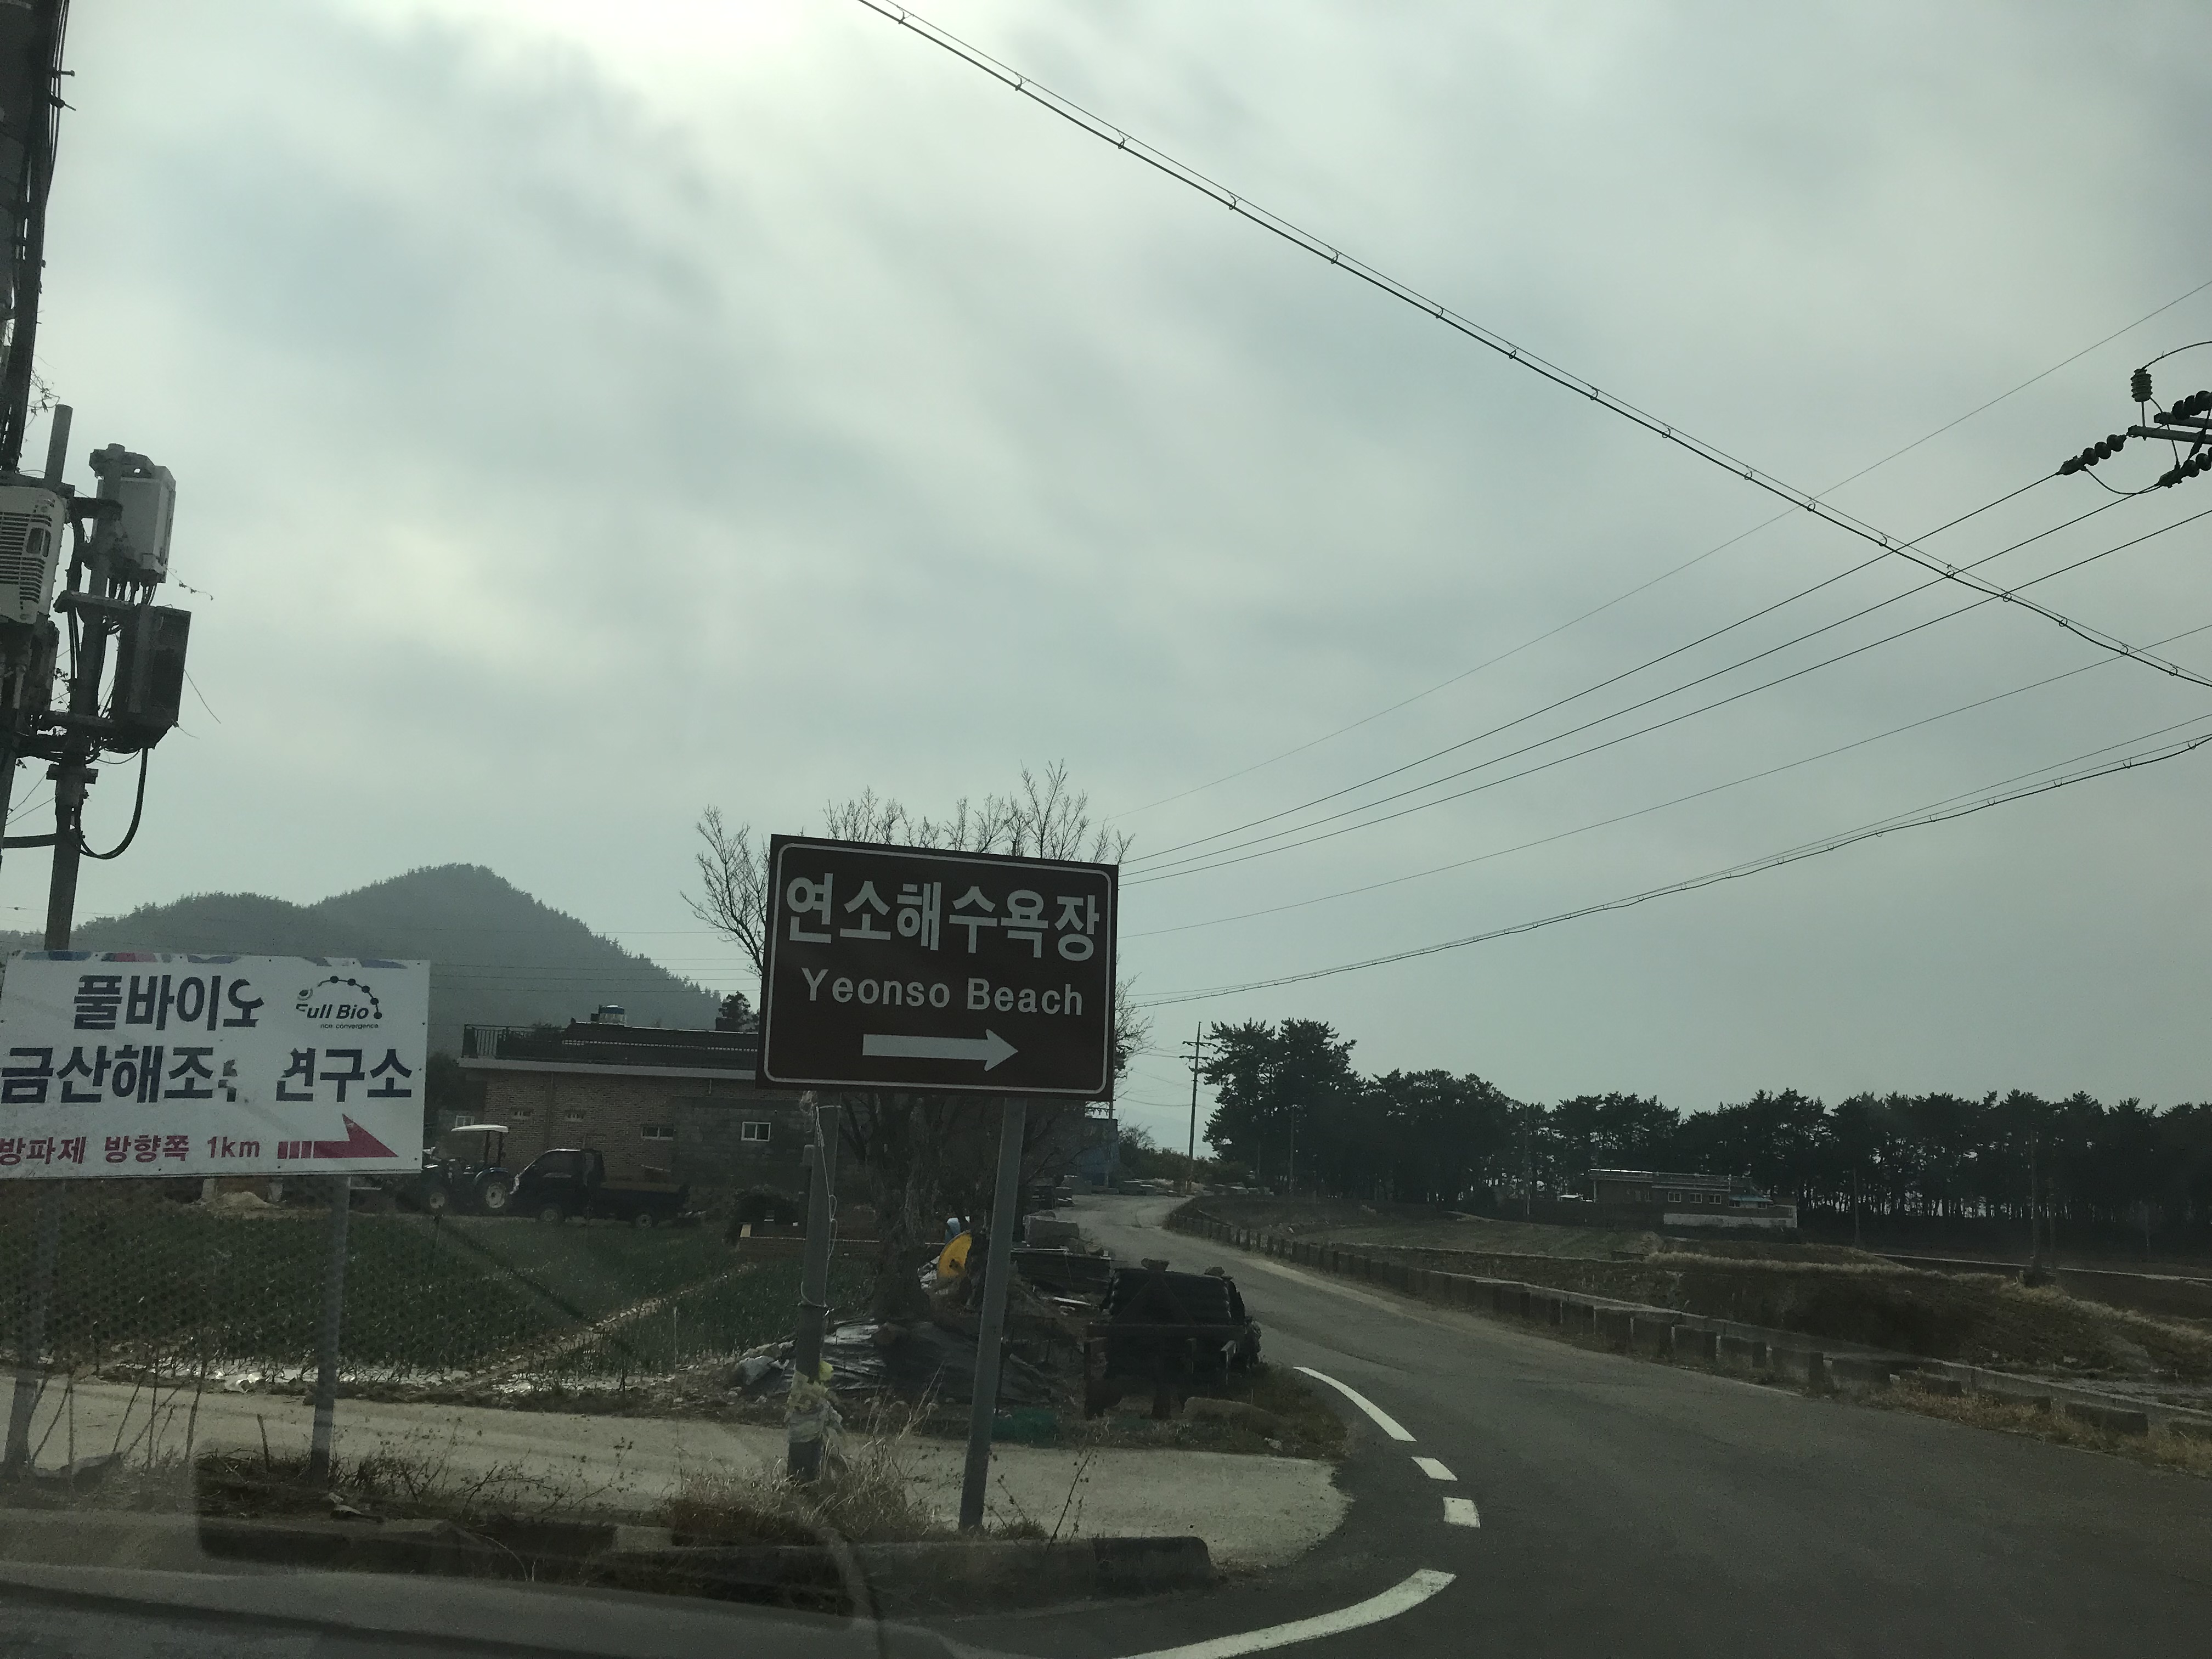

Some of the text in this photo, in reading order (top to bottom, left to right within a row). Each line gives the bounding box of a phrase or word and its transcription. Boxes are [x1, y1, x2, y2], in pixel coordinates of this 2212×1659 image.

[786, 872, 1100, 962] 연소해수욕장
[74, 974, 264, 1031] 풀바이오
[336, 1004, 369, 1019] Bio
[801, 967, 1082, 1015] Yeonso Beach
[0, 1135, 260, 1166] 방파제 방향쪽 1km
